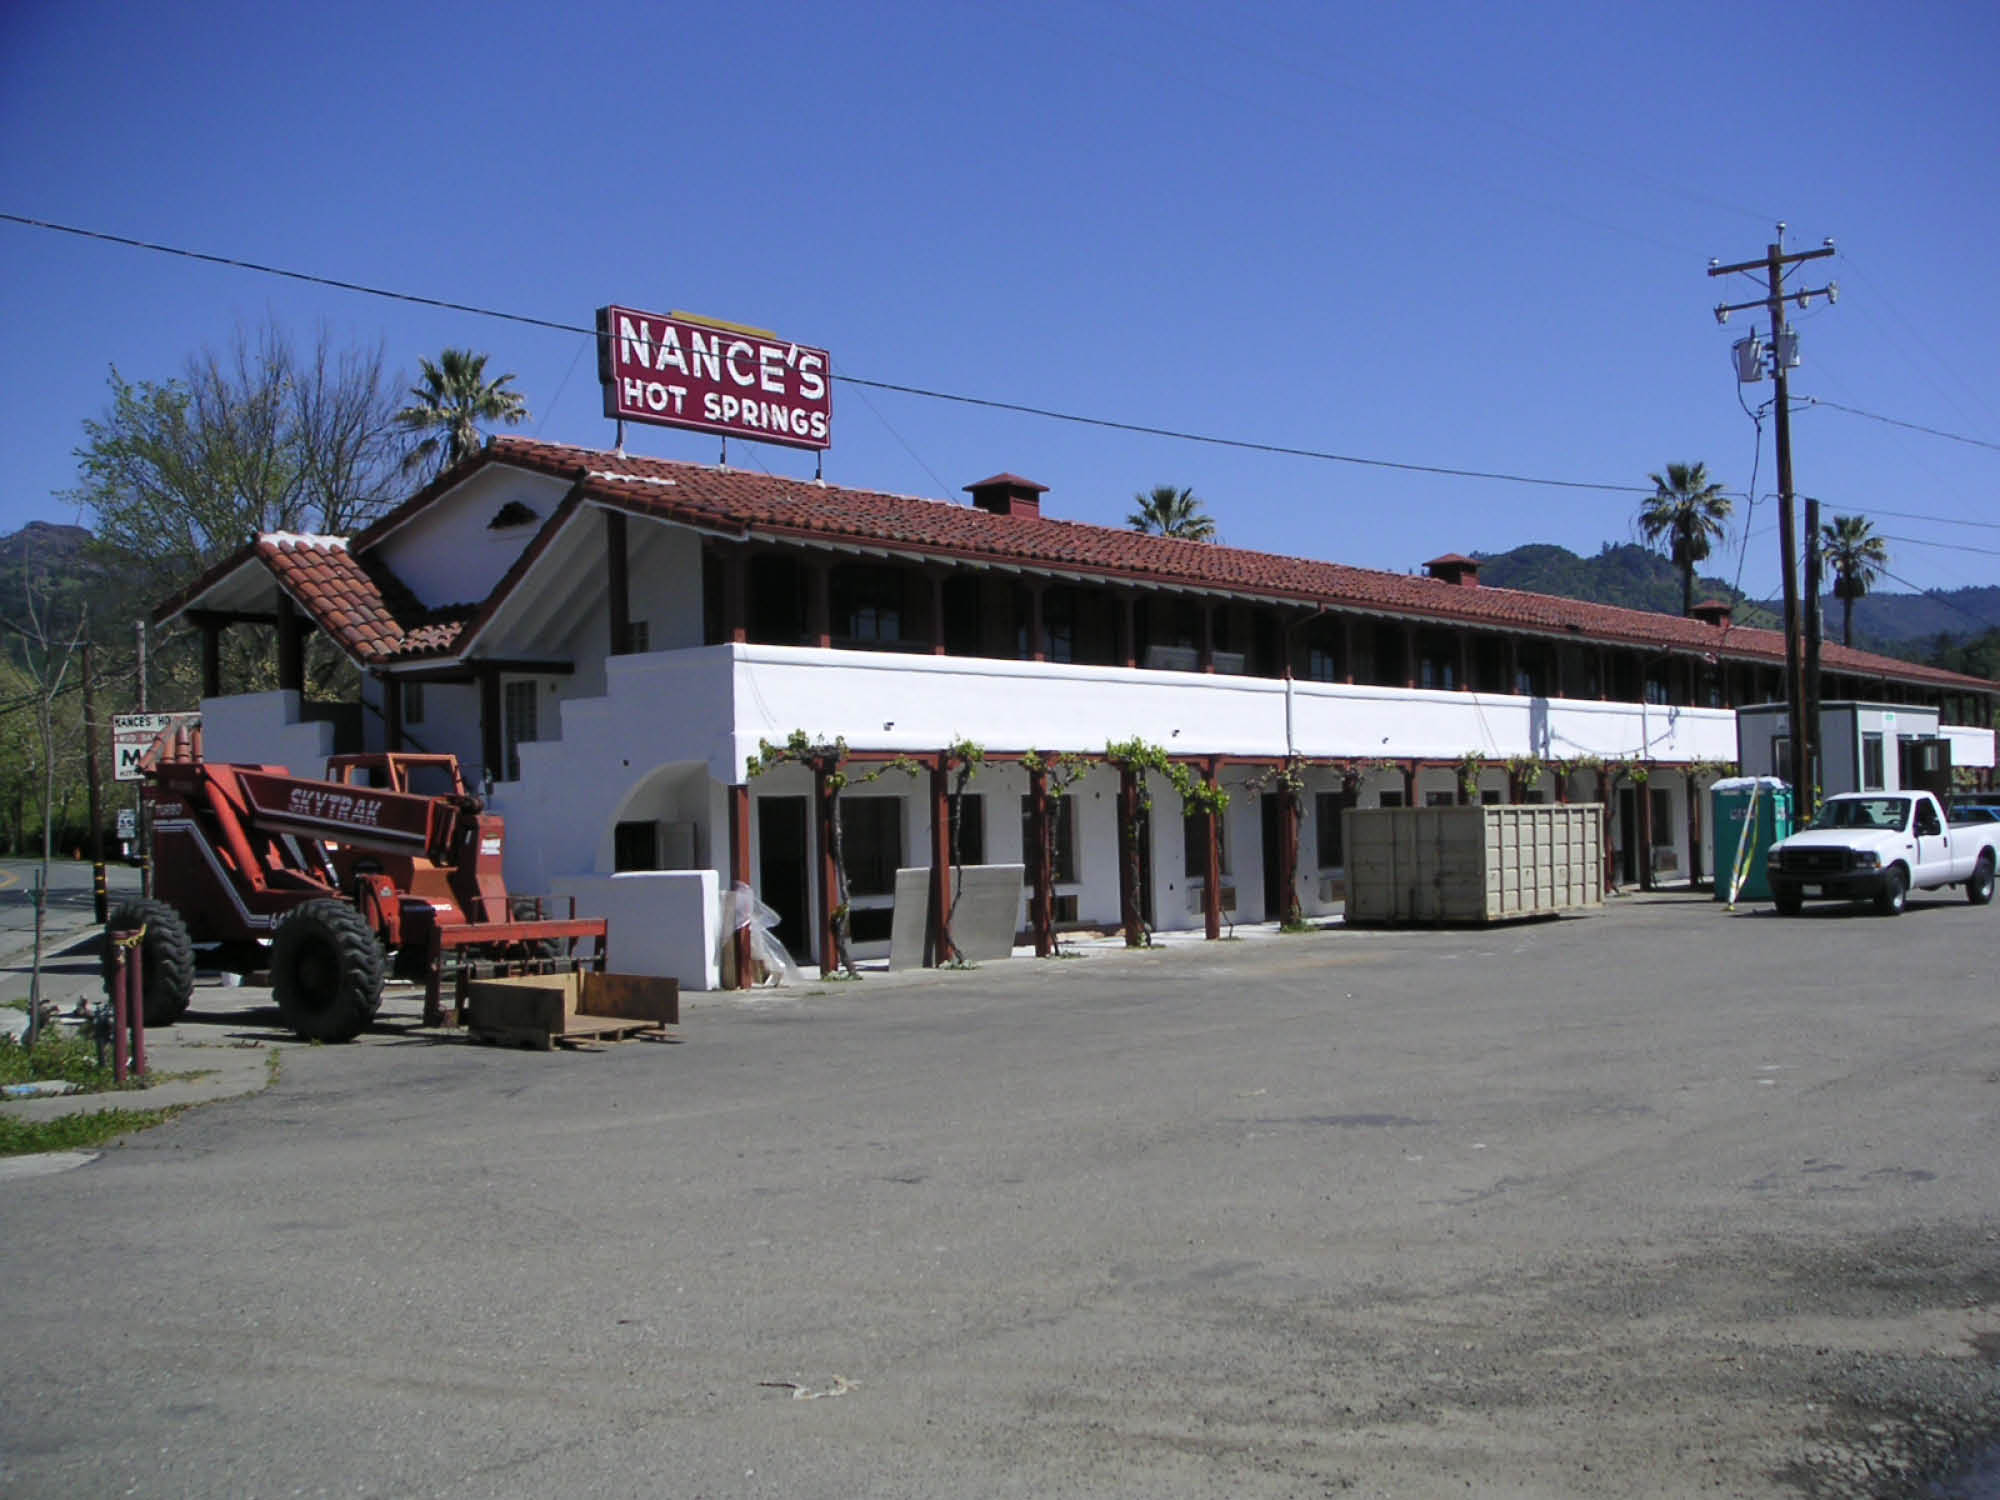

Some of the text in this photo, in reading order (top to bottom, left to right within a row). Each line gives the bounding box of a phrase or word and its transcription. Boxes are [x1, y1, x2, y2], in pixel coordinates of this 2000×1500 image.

[619, 316, 826, 400] NANCE'S
[623, 376, 827, 439] HOT SPRINGS
[288, 788, 383, 825] SKYTRAK
